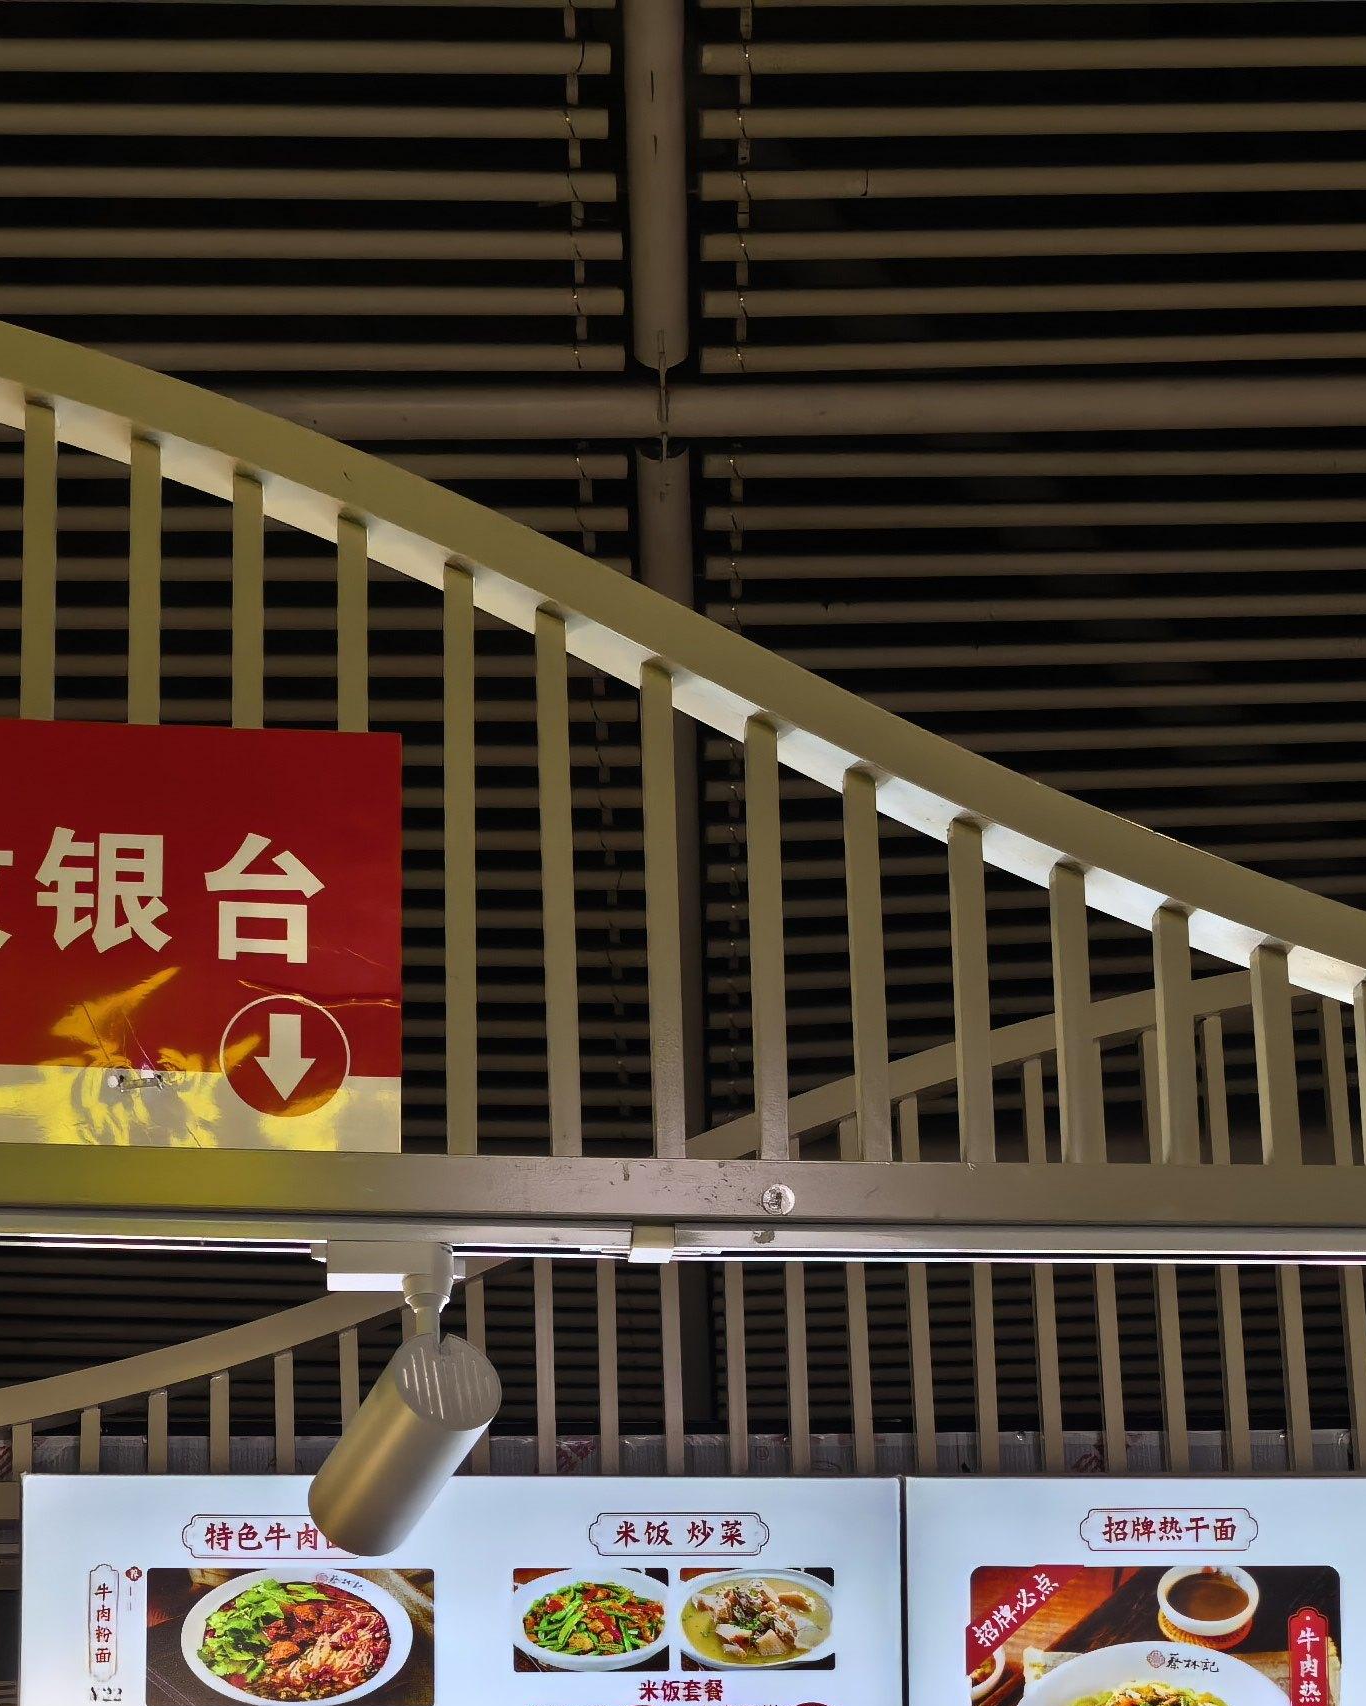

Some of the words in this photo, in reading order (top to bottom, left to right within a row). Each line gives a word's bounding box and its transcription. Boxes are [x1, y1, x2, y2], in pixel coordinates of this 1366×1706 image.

[613, 1520, 673, 1548] 米饭
[687, 1520, 747, 1548] 炒菜
[1102, 1515, 1236, 1542] 招牌热干面
[94, 1583, 113, 1664] 牛肉粉面
[972, 1572, 1059, 1648] 招牌必点
[639, 1679, 723, 1702] 米饭套餐
